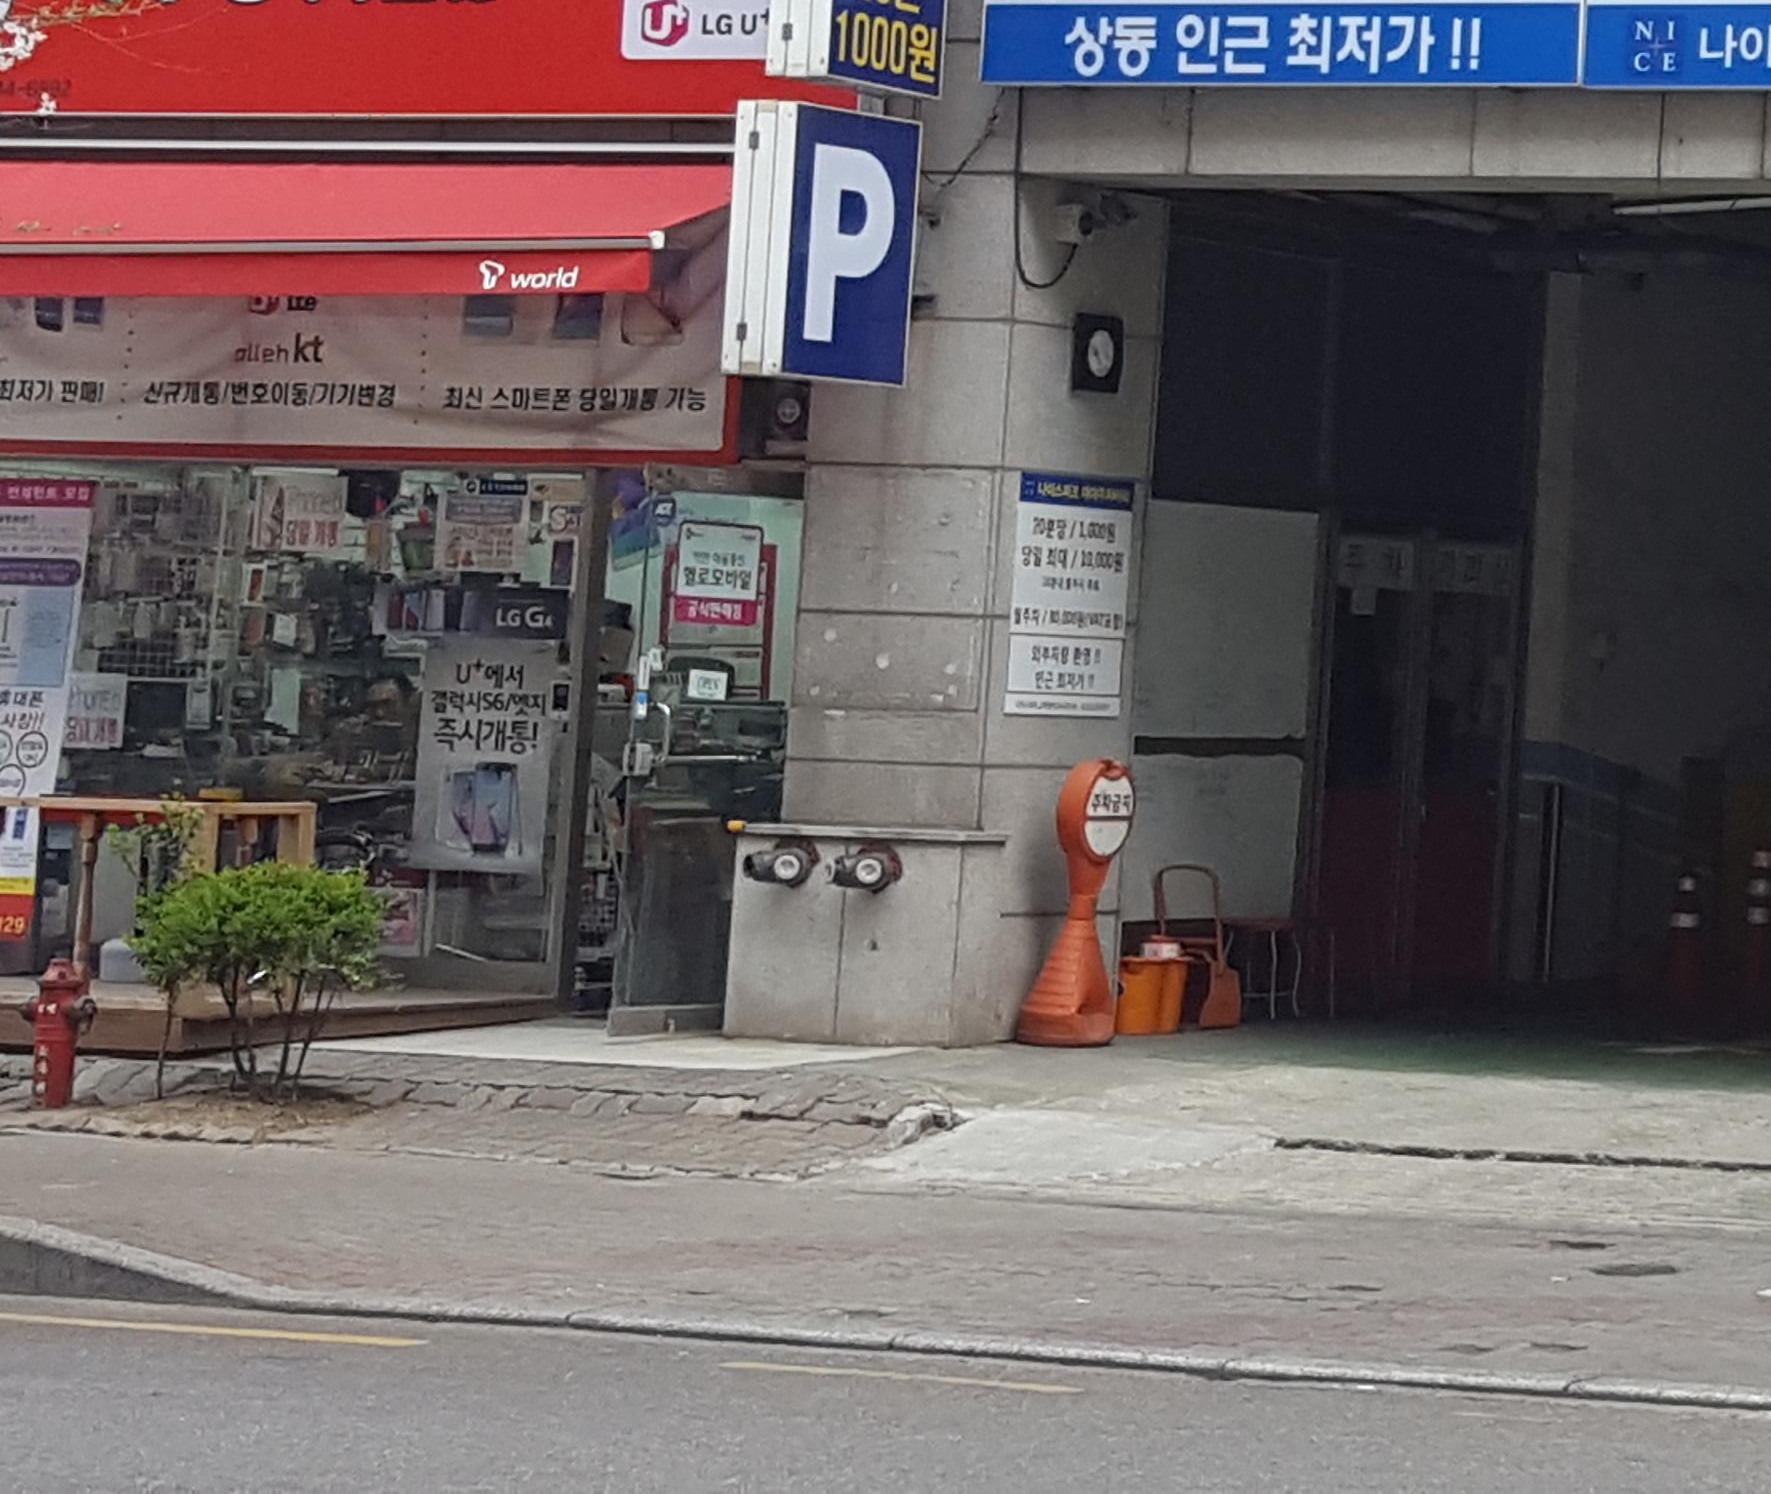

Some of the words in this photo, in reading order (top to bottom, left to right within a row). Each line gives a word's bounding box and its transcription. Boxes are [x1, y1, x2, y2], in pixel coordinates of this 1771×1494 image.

[701, 13, 733, 36] LG
[835, 9, 938, 84] 1000원
[1063, 14, 1156, 78] 상동
[1174, 14, 1270, 76] 인근
[1286, 14, 1436, 76] 최저가
[803, 143, 895, 342] P
[511, 266, 578, 290] world
[292, 332, 324, 364] kt
[444, 386, 483, 410] 최신
[489, 386, 571, 412] 스마트폰
[664, 387, 707, 412] 기능
[496, 609, 520, 626] LG
[433, 718, 539, 755] 즉시개통!
